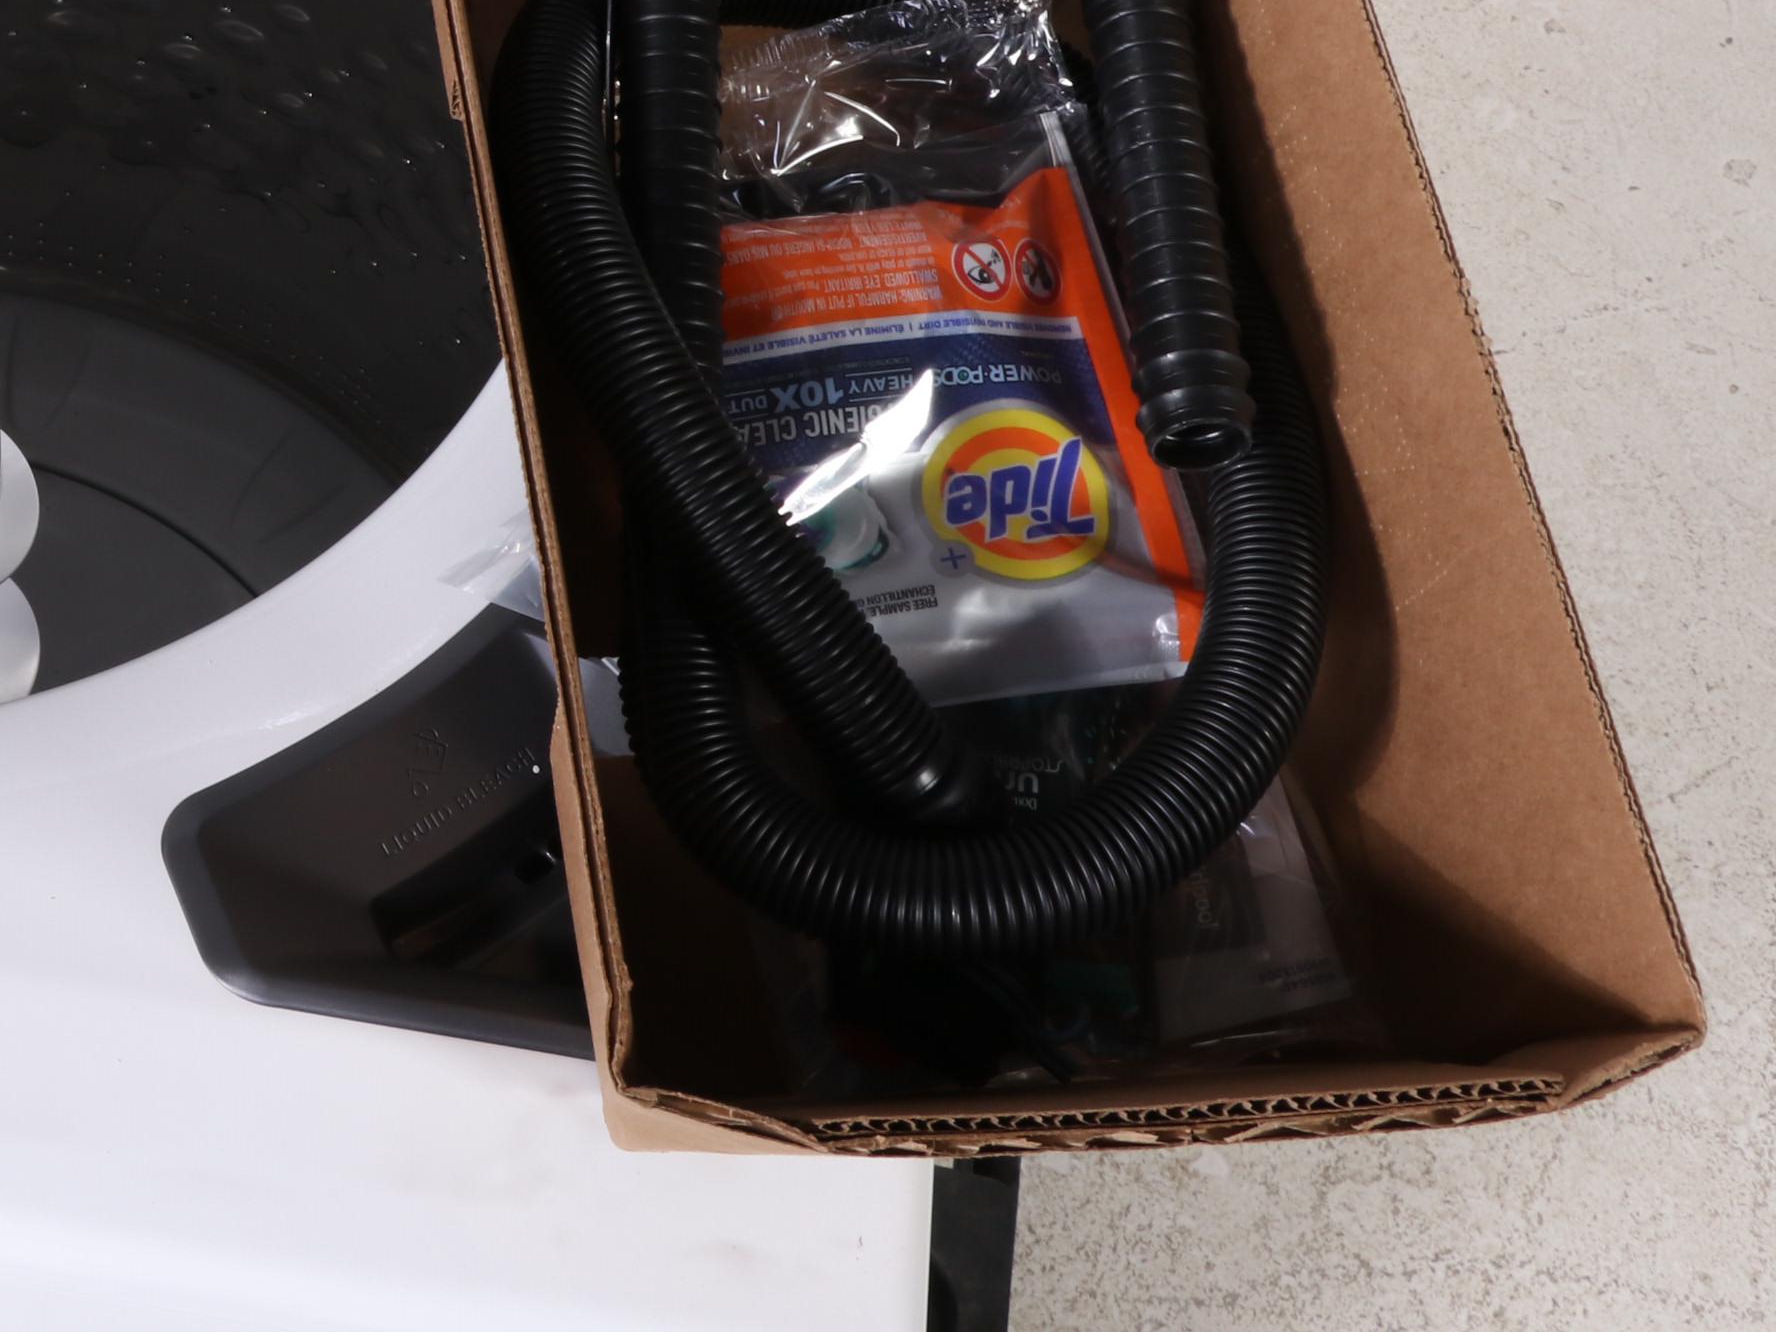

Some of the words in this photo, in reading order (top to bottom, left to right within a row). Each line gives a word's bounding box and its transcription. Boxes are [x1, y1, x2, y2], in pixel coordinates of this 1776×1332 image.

[863, 274, 880, 288] EYE
[816, 297, 825, 312] IN
[828, 294, 845, 310] PUT
[847, 295, 854, 308] IF
[855, 290, 897, 308] HARMFUL
[784, 299, 814, 317] MOUTH
[864, 323, 904, 336] ÉLIMINE
[918, 320, 941, 330] DIRT
[808, 330, 847, 344] SALETÉ
[848, 327, 862, 339] LA
[753, 343, 765, 353] ET
[768, 336, 805, 351] VISIBLE
[848, 373, 913, 394] HEAVY
[769, 376, 844, 413] 10X
[726, 395, 768, 414] DUT
[732, 416, 797, 447] CLEA
[945, 436, 1095, 543] Tide
[866, 585, 936, 606] ÉCHANTILLON
[912, 597, 938, 611] FREE
[381, 805, 453, 856] LIQUID
[455, 746, 536, 811] BLEACH
